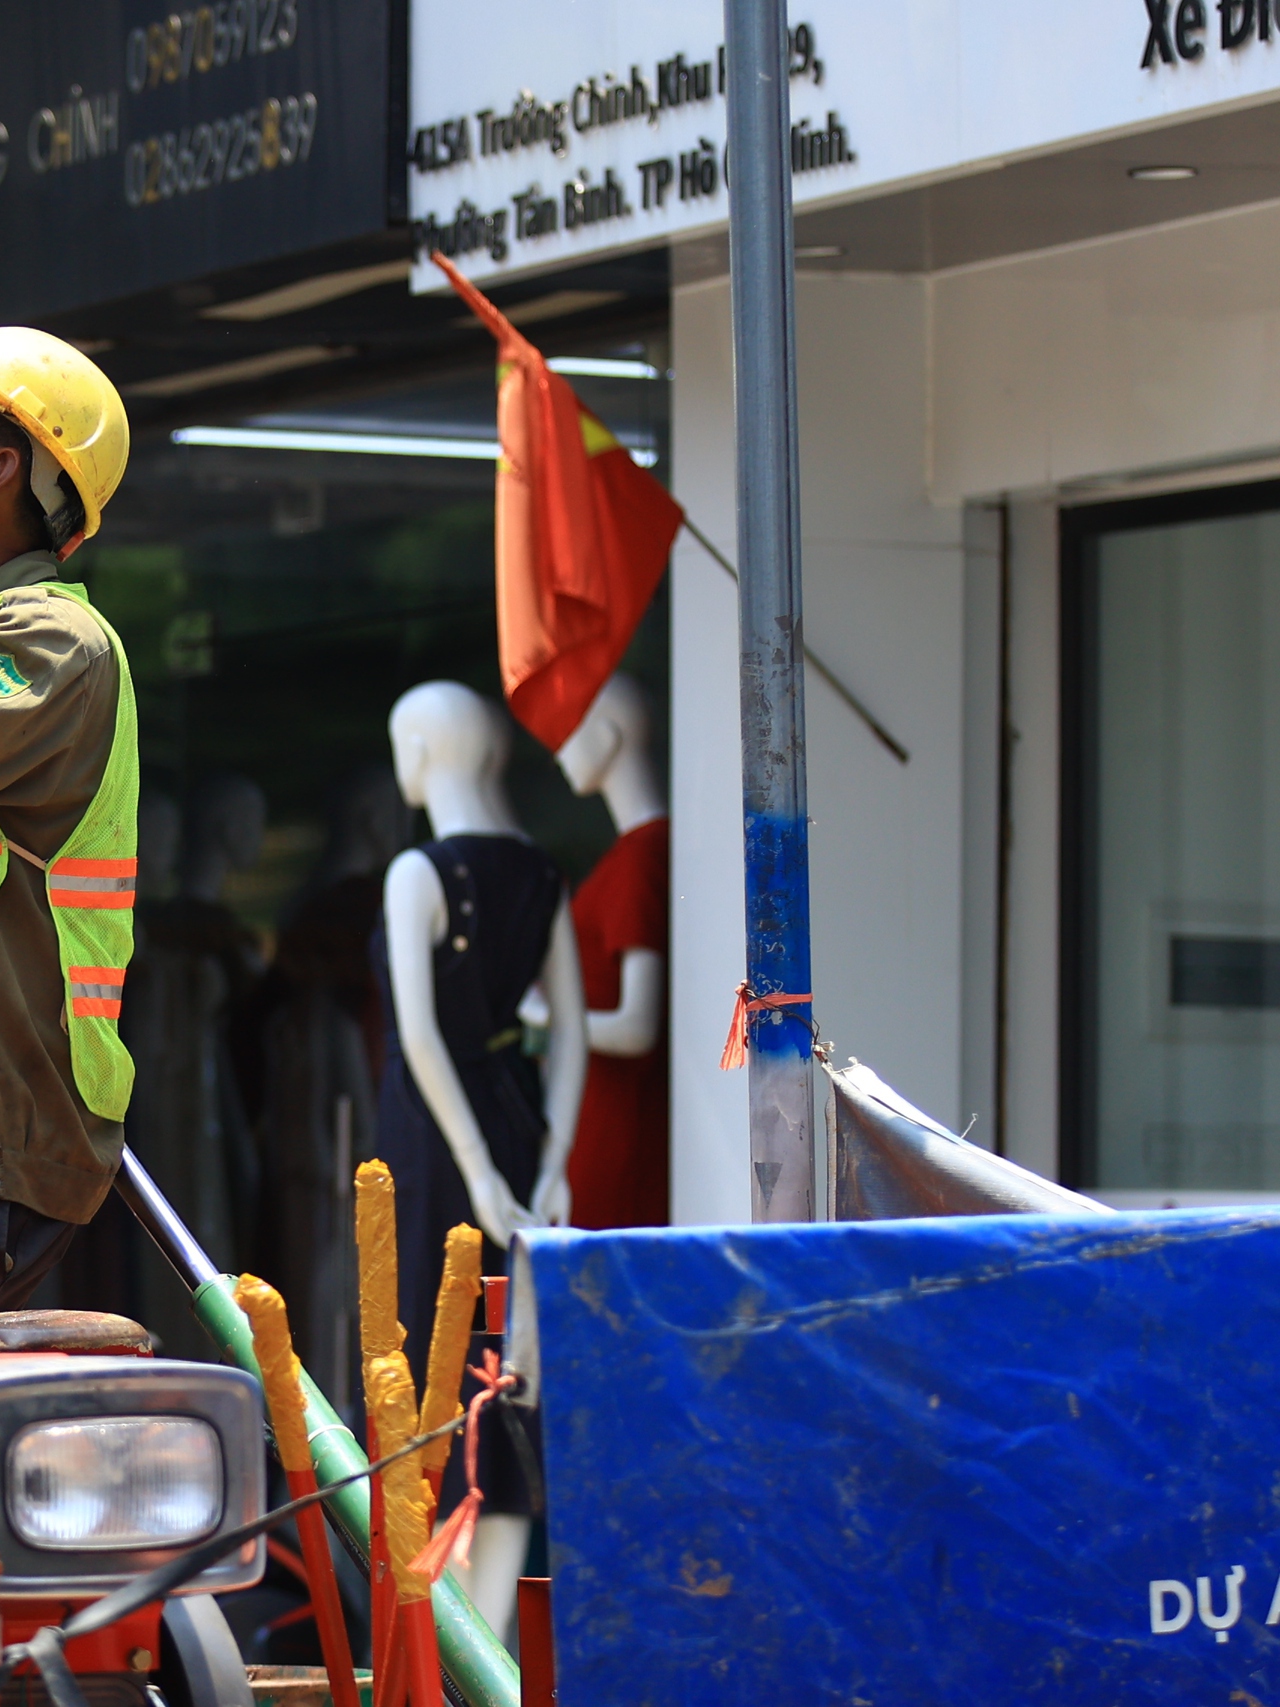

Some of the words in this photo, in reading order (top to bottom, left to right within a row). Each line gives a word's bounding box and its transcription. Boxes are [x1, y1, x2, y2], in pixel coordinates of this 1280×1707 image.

[1140, 0, 1206, 69] Xe
[638, 158, 673, 210] TP
[680, 136, 717, 201] Hồ
[1149, 1564, 1246, 1643] DỰ
